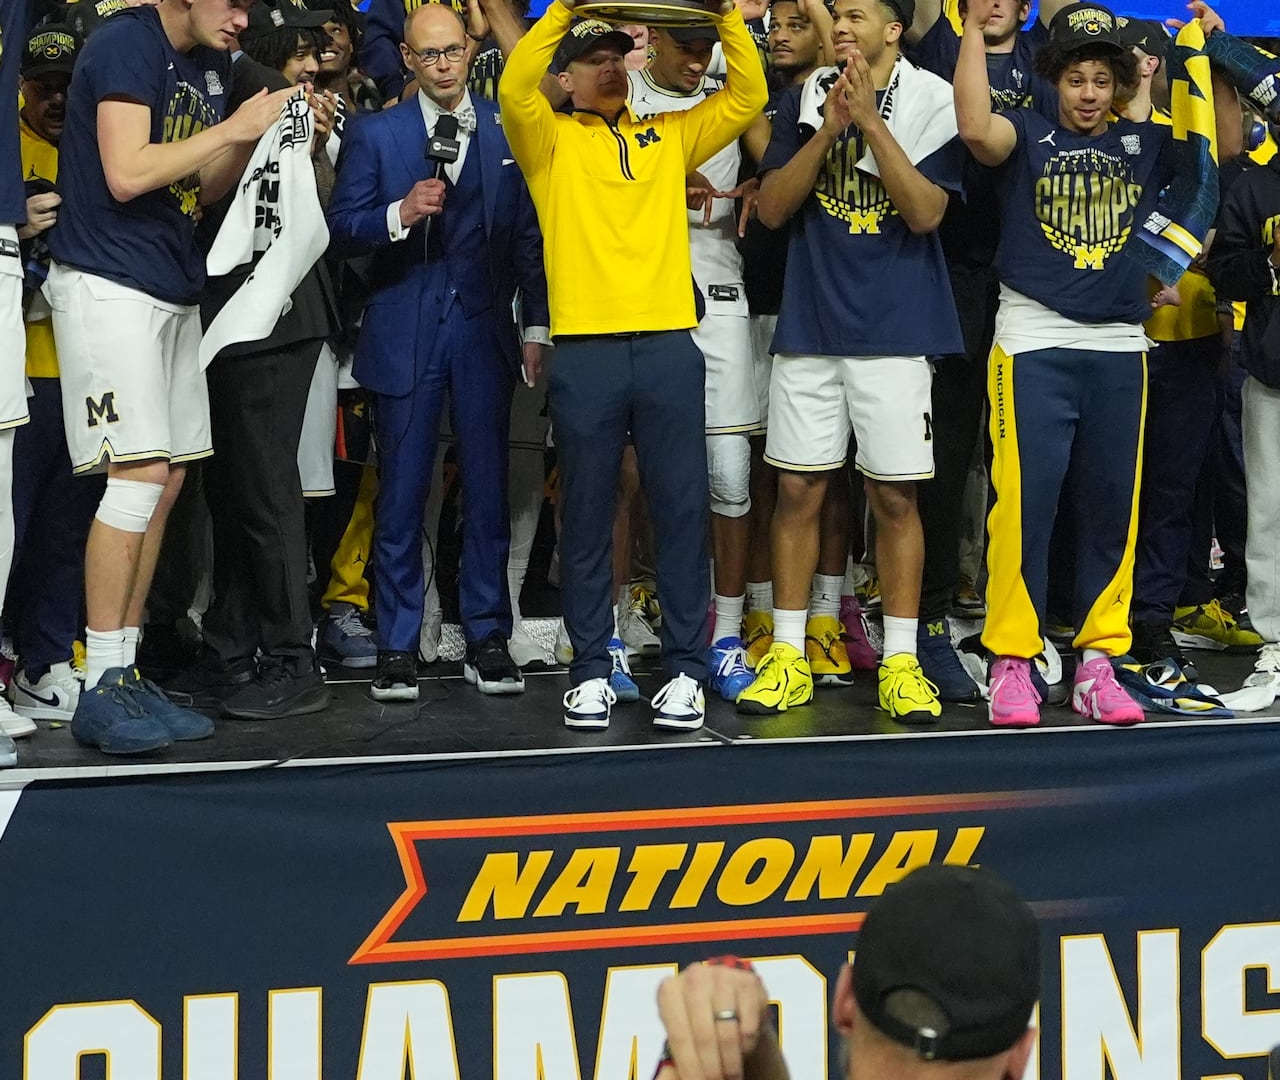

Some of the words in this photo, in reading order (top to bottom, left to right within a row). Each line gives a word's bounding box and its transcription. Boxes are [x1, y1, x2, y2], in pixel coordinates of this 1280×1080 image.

[1068, 7, 1112, 27] CHAMPIONS
[28, 34, 76, 52] CHAMPIONS
[634, 127, 662, 149] M
[1035, 171, 1143, 243] CHAMPS
[848, 211, 882, 235] M
[1073, 245, 1105, 270] M
[85, 391, 120, 428] M
[996, 363, 1006, 440] MICHIGAN
[927, 622, 946, 637] M
[456, 826, 986, 922] NATIONAL
